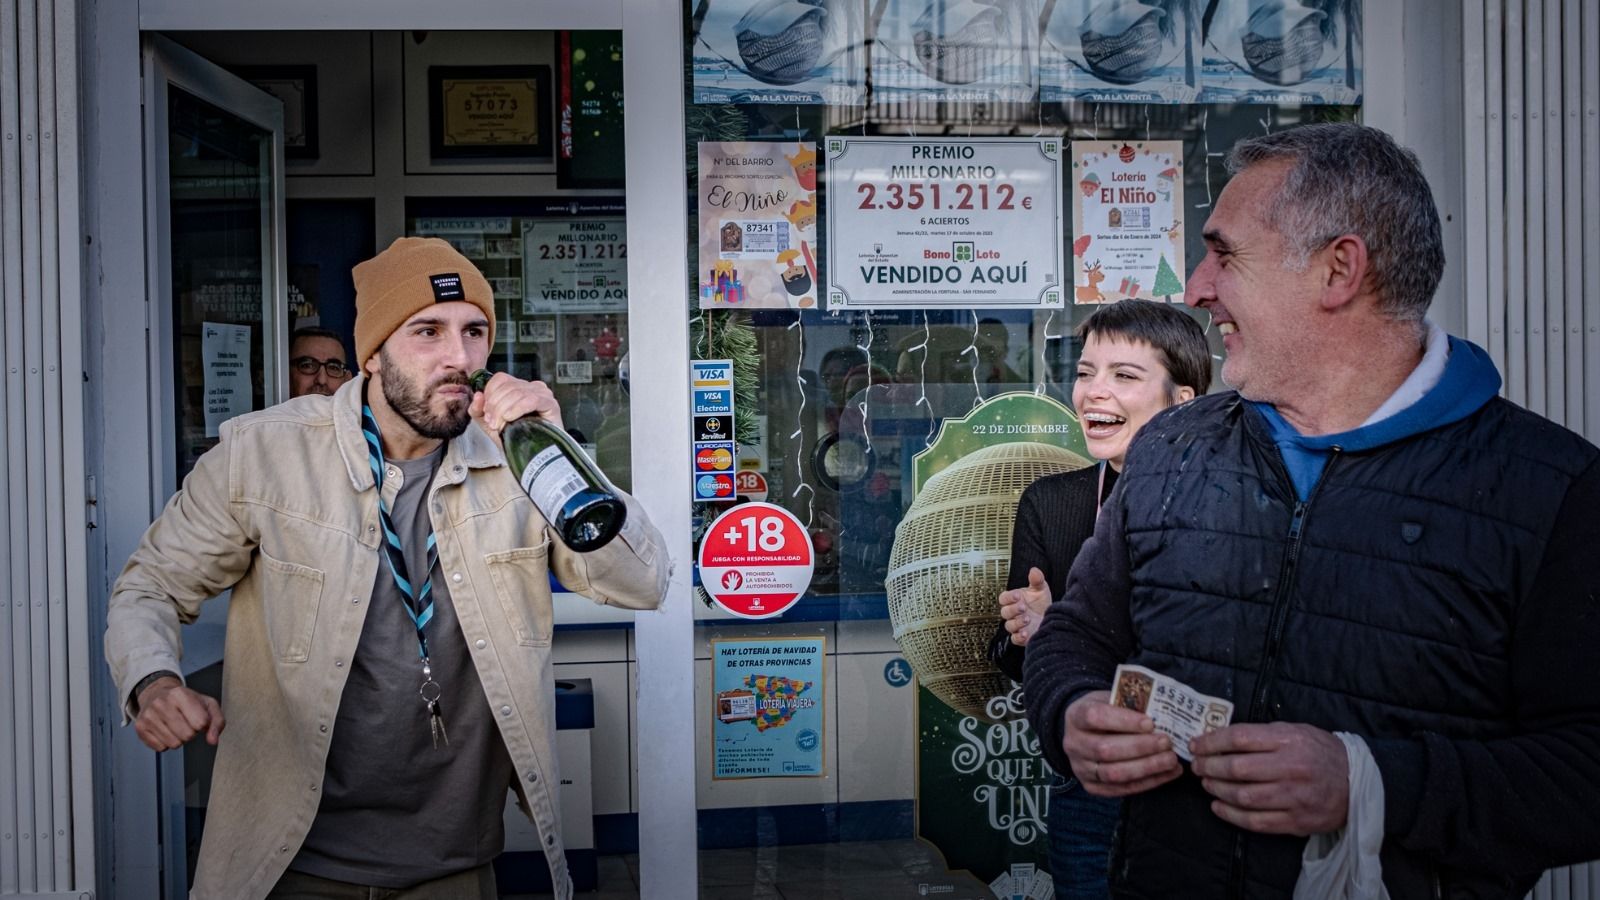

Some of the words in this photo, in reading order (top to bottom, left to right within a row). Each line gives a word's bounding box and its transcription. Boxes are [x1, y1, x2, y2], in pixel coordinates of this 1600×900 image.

[912, 145, 975, 159] PREMIO
[726, 158, 740, 166] DEL
[742, 158, 774, 166] BARRIO
[891, 164, 996, 179] MILLONARIO
[1111, 171, 1147, 182] Lotería
[707, 185, 733, 209] El
[735, 189, 788, 212] Niño
[857, 183, 1015, 210] 2.351.212
[1021, 196, 1032, 210] €
[1101, 187, 1114, 204] El
[1119, 186, 1156, 204] Niño
[920, 217, 926, 225] 6
[928, 216, 970, 225] ACIERTOS
[569, 222, 605, 231] PREMIO
[746, 224, 773, 233] 87341
[558, 233, 618, 242] MILLONARIO
[539, 244, 627, 260] 2.351.212
[923, 249, 951, 259] Bono
[976, 249, 1001, 259] Loto
[860, 266, 962, 283] VENDIDO
[970, 261, 1028, 284] AQUÍ
[541, 289, 598, 300] VENDIDO
[604, 288, 627, 300] AQ
[700, 370, 725, 380] VISA
[703, 392, 722, 400] VISA
[972, 425, 986, 434] 22
[989, 425, 1005, 434] DE
[1007, 424, 1069, 434] DICIEMBRE
[701, 432, 726, 440] ServiRed
[697, 456, 732, 464] MasterCard
[723, 516, 786, 552] +18
[721, 648, 737, 656] HAY
[738, 646, 770, 656] LOTERÍA
[771, 647, 782, 655] DE
[783, 646, 817, 655] NAVIDAD
[727, 660, 737, 668] DE
[739, 659, 764, 668] OTRAS
[765, 658, 812, 667] PROVINCIAS
[787, 697, 812, 710] VIAJERA
[1156, 685, 1206, 717] 45353
[986, 757, 1034, 786] QUE
